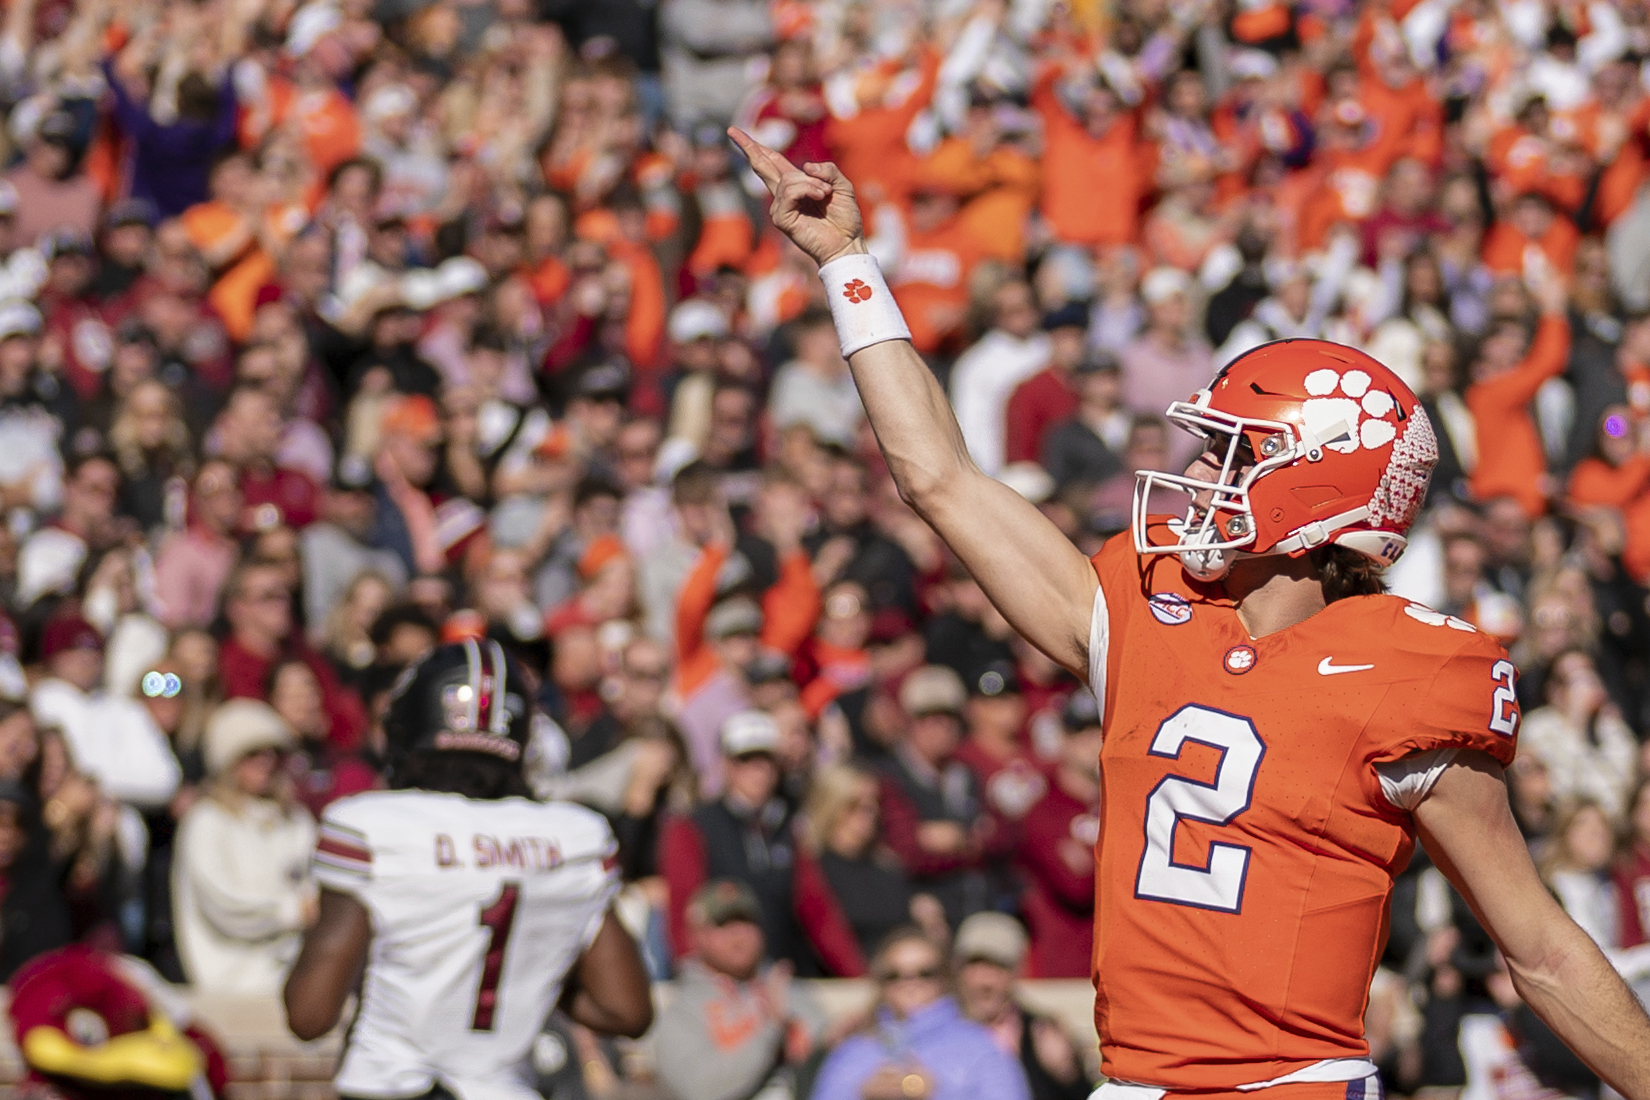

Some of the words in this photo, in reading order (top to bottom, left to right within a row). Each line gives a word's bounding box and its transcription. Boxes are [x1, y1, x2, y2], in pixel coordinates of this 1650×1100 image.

[1488, 658, 1518, 738] 2
[435, 833, 464, 869] D.
[473, 833, 564, 872] SMITH
[1134, 702, 1267, 915] 2
[470, 880, 522, 1034] 1
